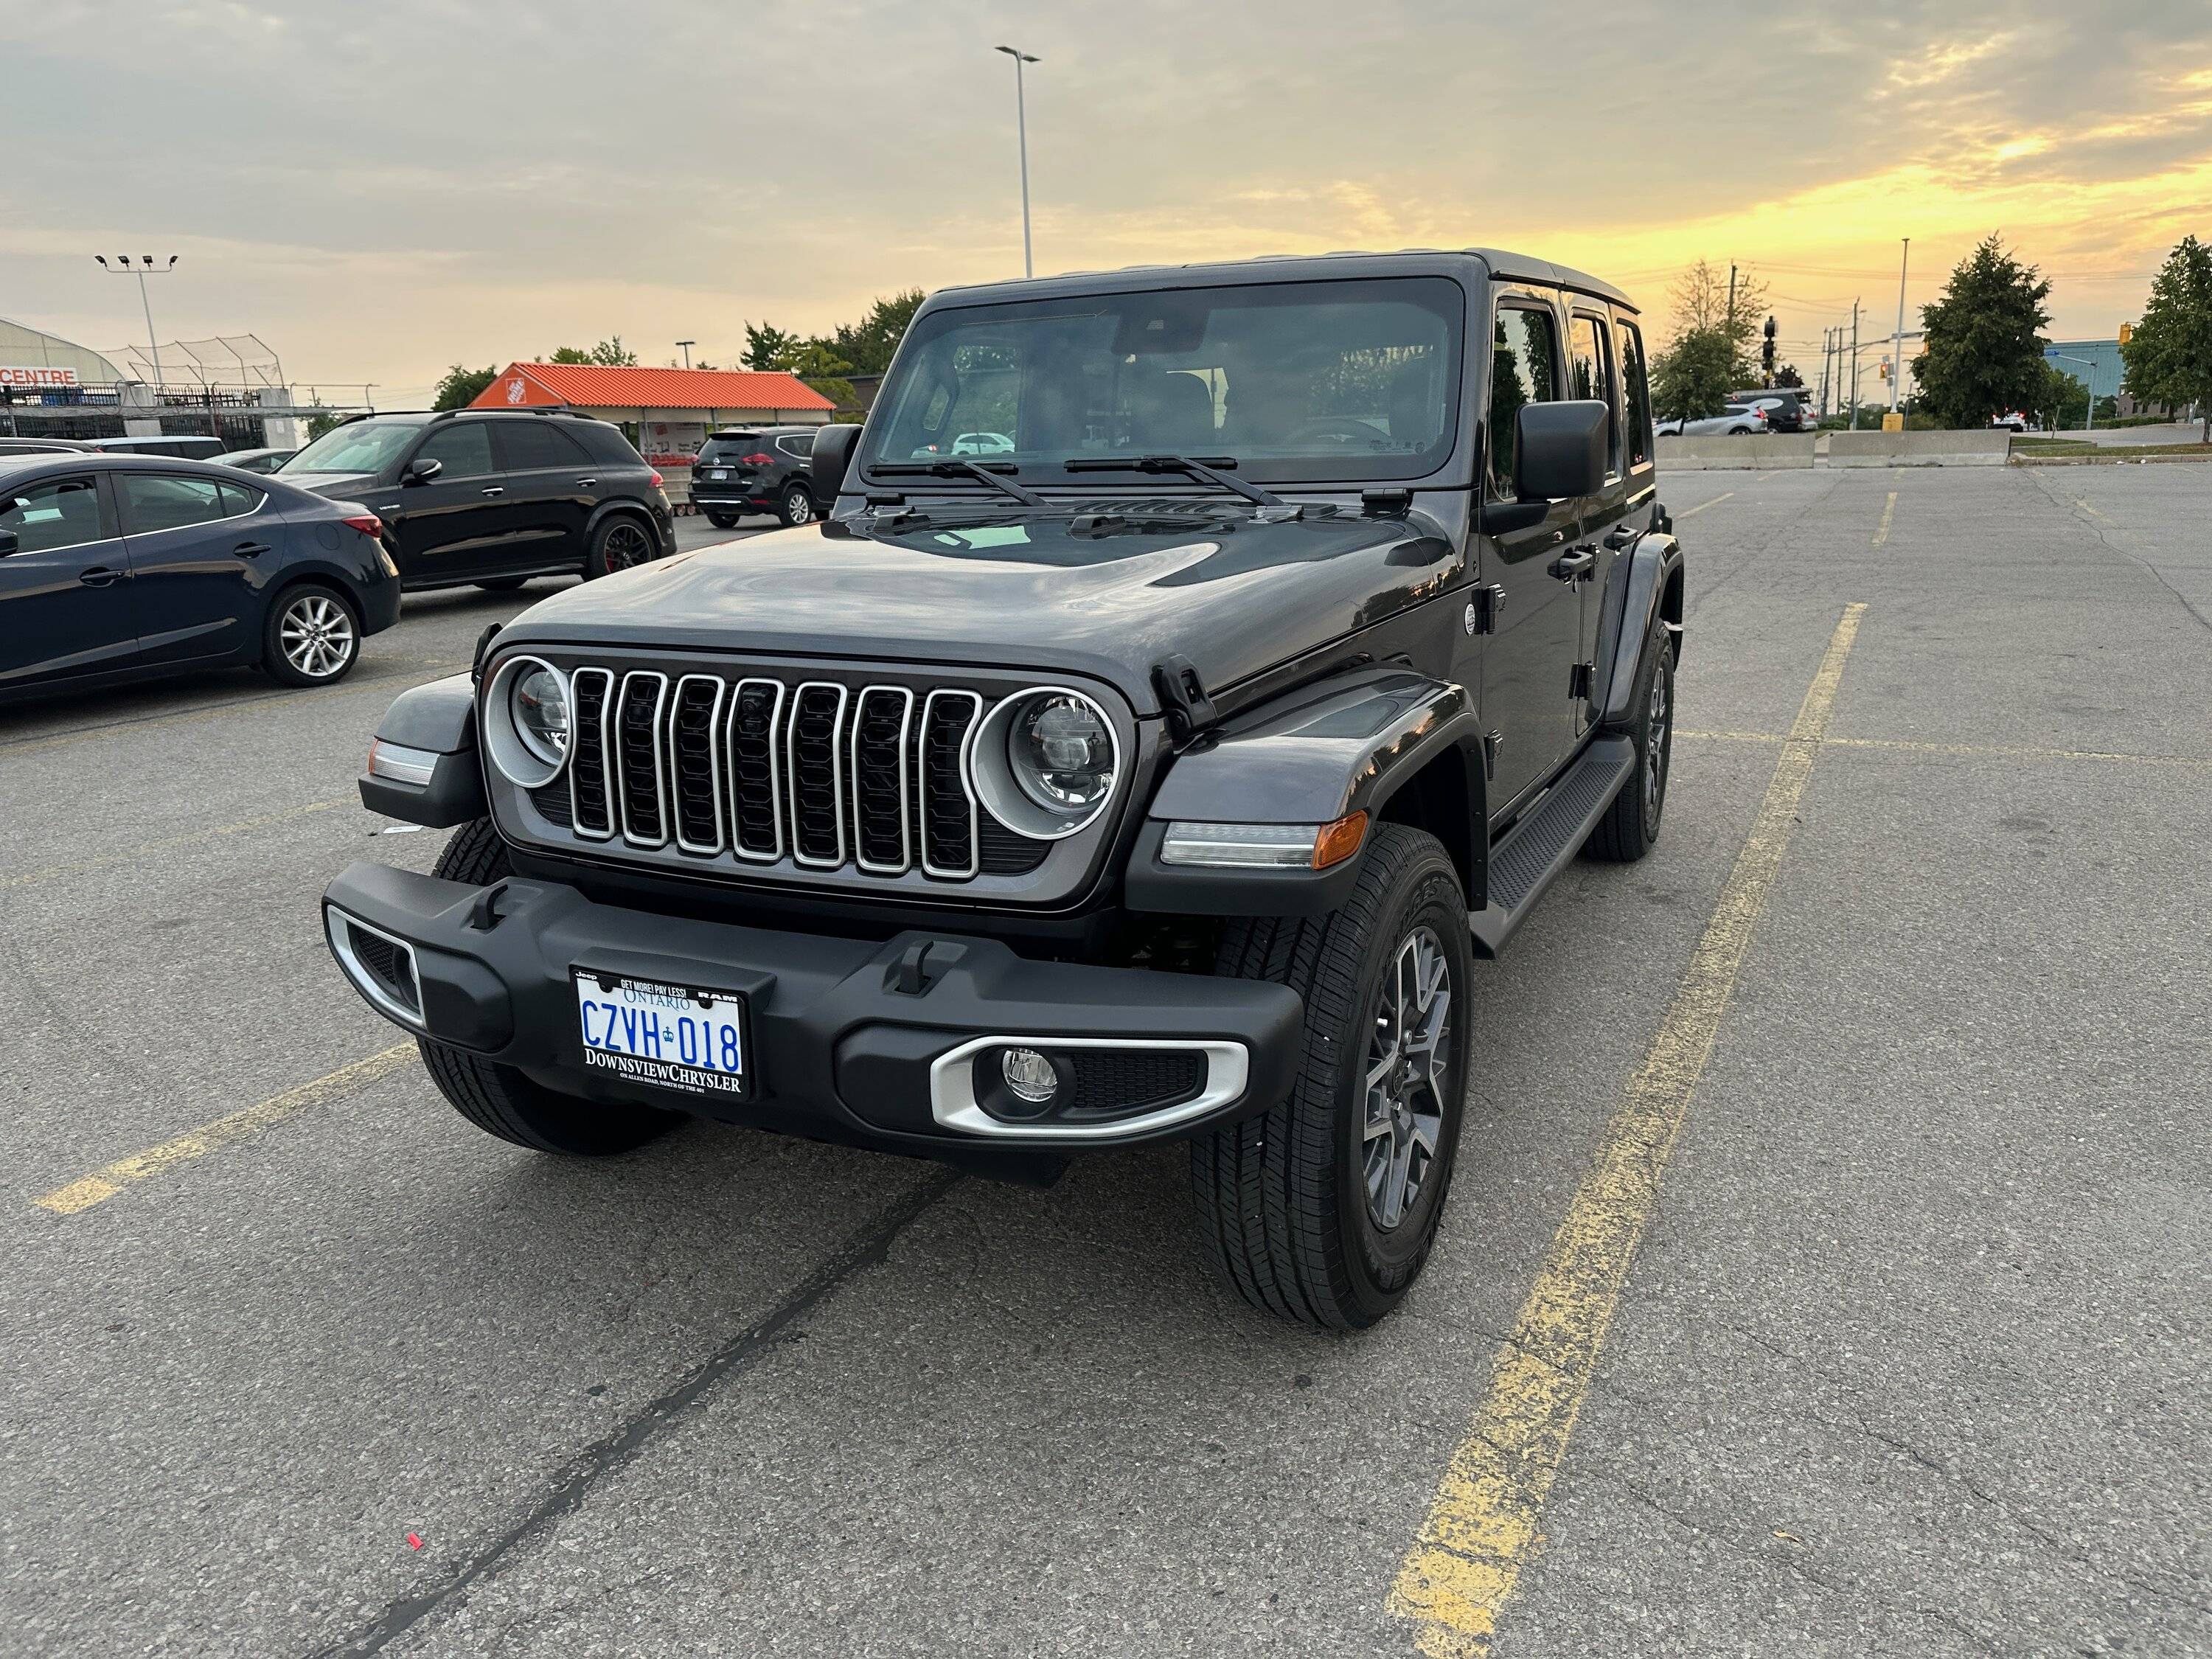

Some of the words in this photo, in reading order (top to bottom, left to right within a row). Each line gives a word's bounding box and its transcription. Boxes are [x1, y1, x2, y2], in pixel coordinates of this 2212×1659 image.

[0, 369, 76, 384] CENTRE
[575, 971, 597, 980] Jeep
[620, 978, 633, 990] GET
[633, 981, 654, 993] MORE!
[655, 984, 667, 995] PAY
[668, 987, 686, 998] LESS!
[624, 989, 690, 1012] ONTARIO
[698, 992, 737, 1002] RAM
[582, 1000, 661, 1058] CZVH
[678, 1017, 738, 1071] 018
[660, 1080, 677, 1088] NORTH
